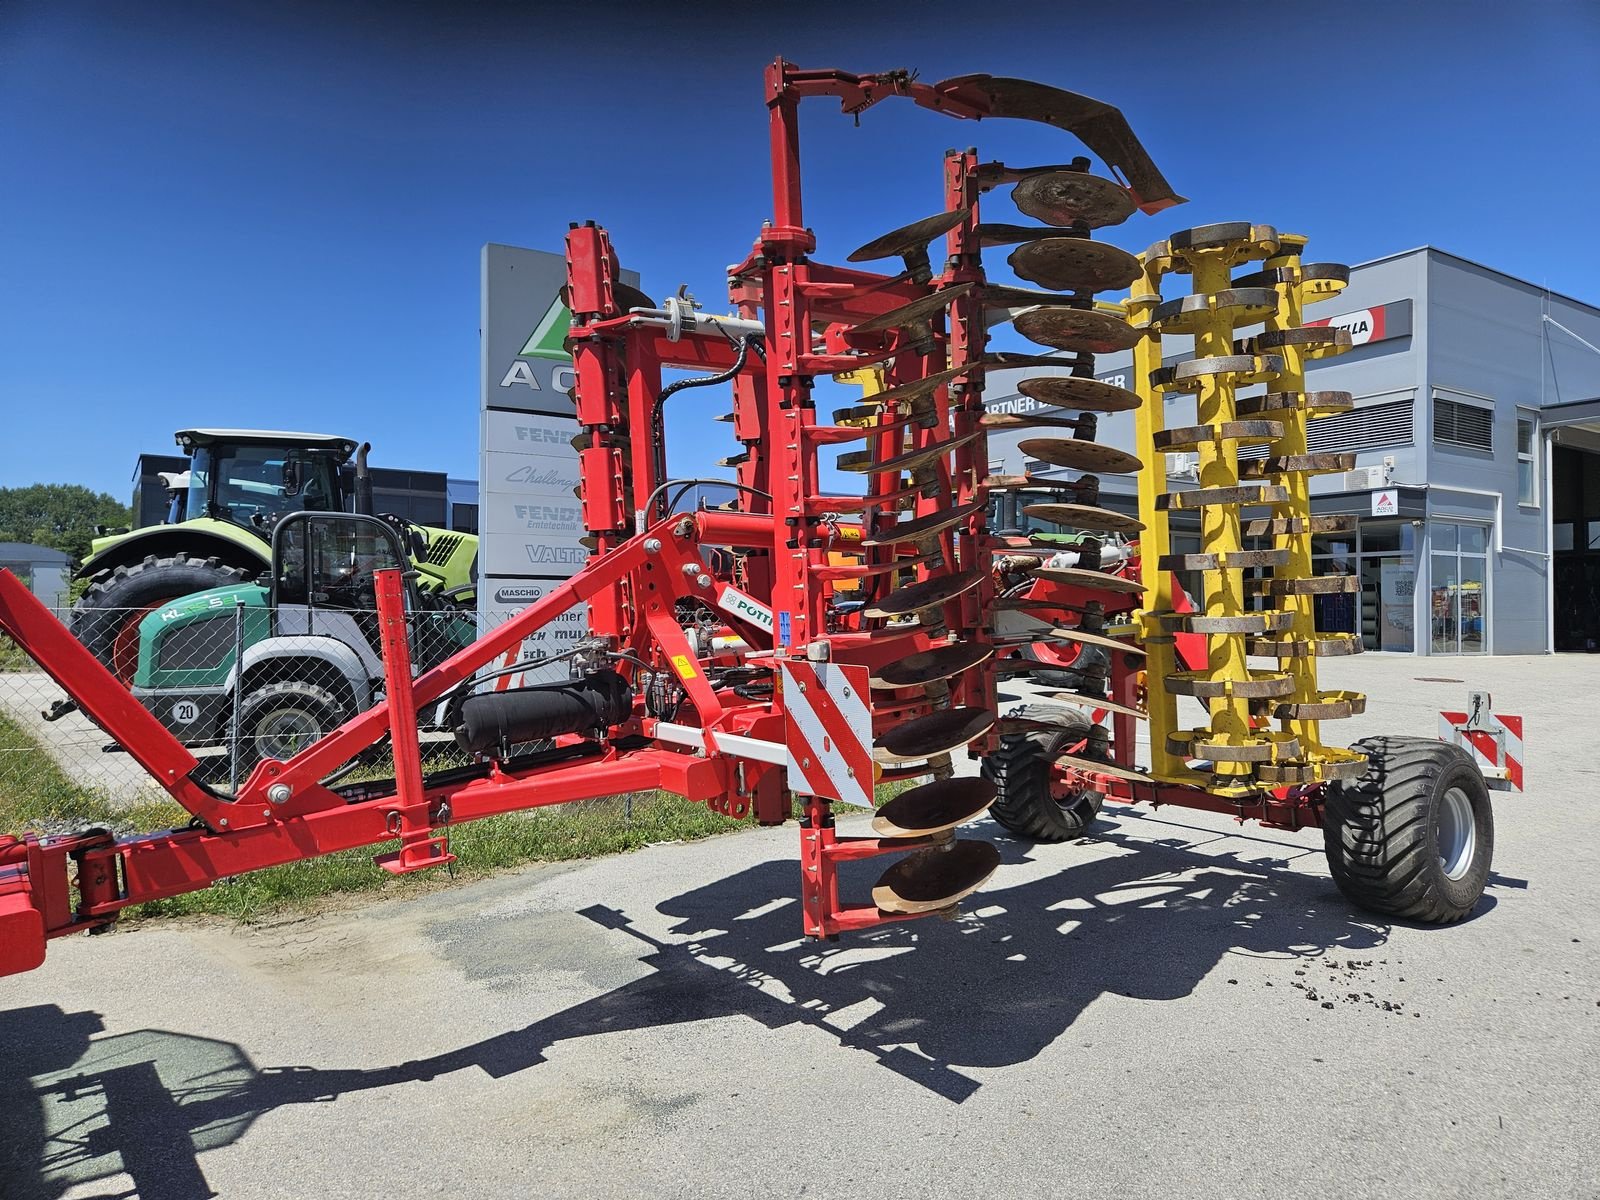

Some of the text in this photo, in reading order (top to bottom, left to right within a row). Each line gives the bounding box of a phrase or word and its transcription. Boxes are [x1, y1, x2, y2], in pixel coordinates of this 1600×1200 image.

[515, 426, 576, 444] FEND
[505, 465, 581, 493] Challenge
[527, 520, 578, 531] Erntetechnik
[525, 545, 588, 564] VALTR
[501, 589, 541, 597] MASCHIO
[178, 705, 194, 720] 20
